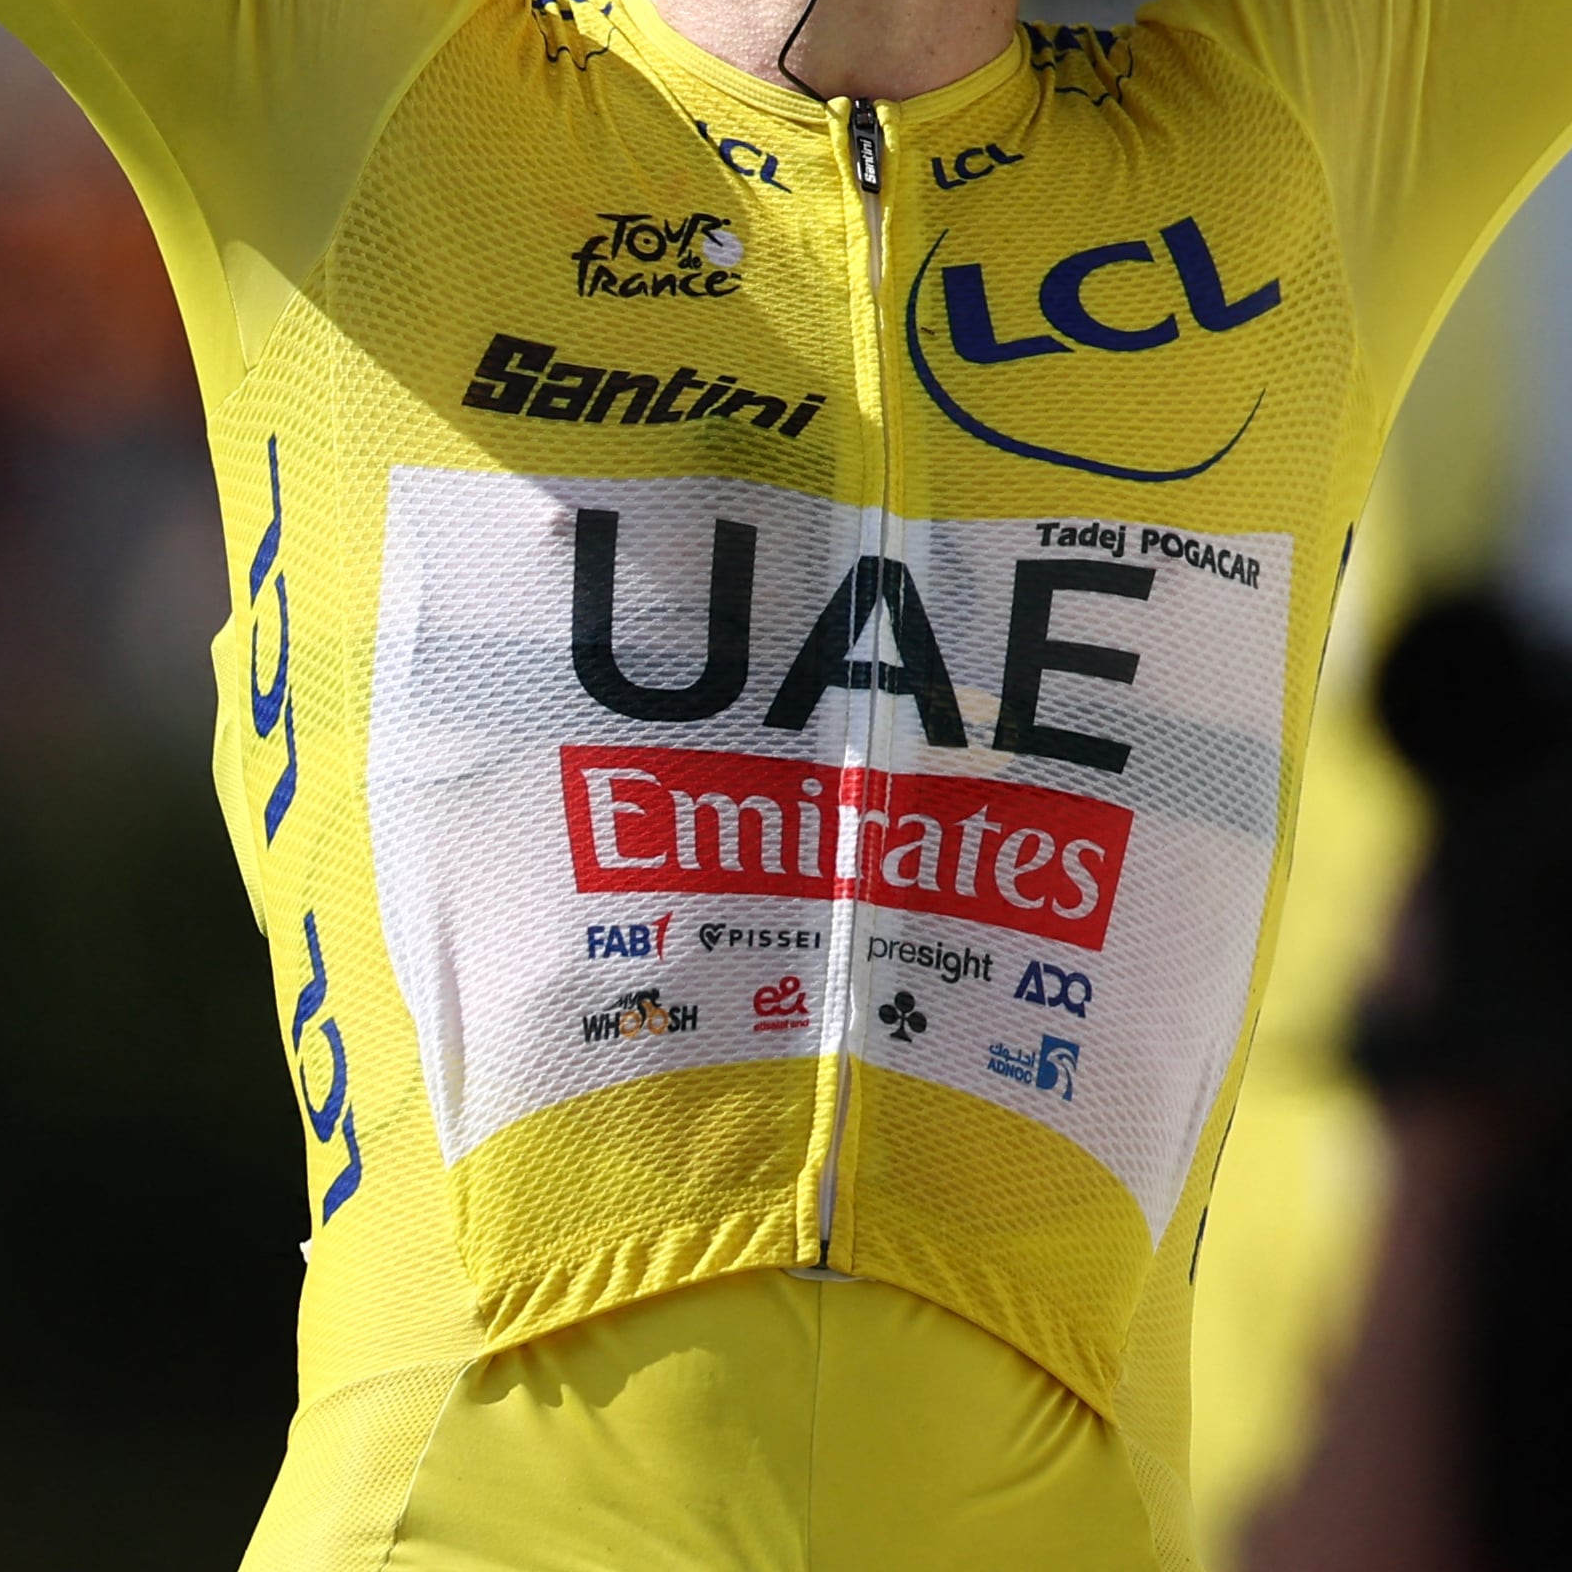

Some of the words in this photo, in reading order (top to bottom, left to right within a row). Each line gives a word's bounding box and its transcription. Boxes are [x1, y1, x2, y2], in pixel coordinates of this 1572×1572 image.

[859, 138, 878, 185] Santini
[931, 142, 1025, 190] LCL
[678, 249, 703, 270] de
[941, 216, 1282, 364] LCL
[461, 332, 827, 438] Santini
[1036, 522, 1127, 558] Tadej
[1140, 528, 1261, 590] POGACAR
[571, 508, 1157, 775] UAE
[580, 766, 1110, 922] Emirates
[728, 928, 821, 950] PISSEI
[866, 935, 994, 984] presight
[1013, 959, 1093, 1019] ADQ
[987, 1057, 1034, 1085] ADNOC
